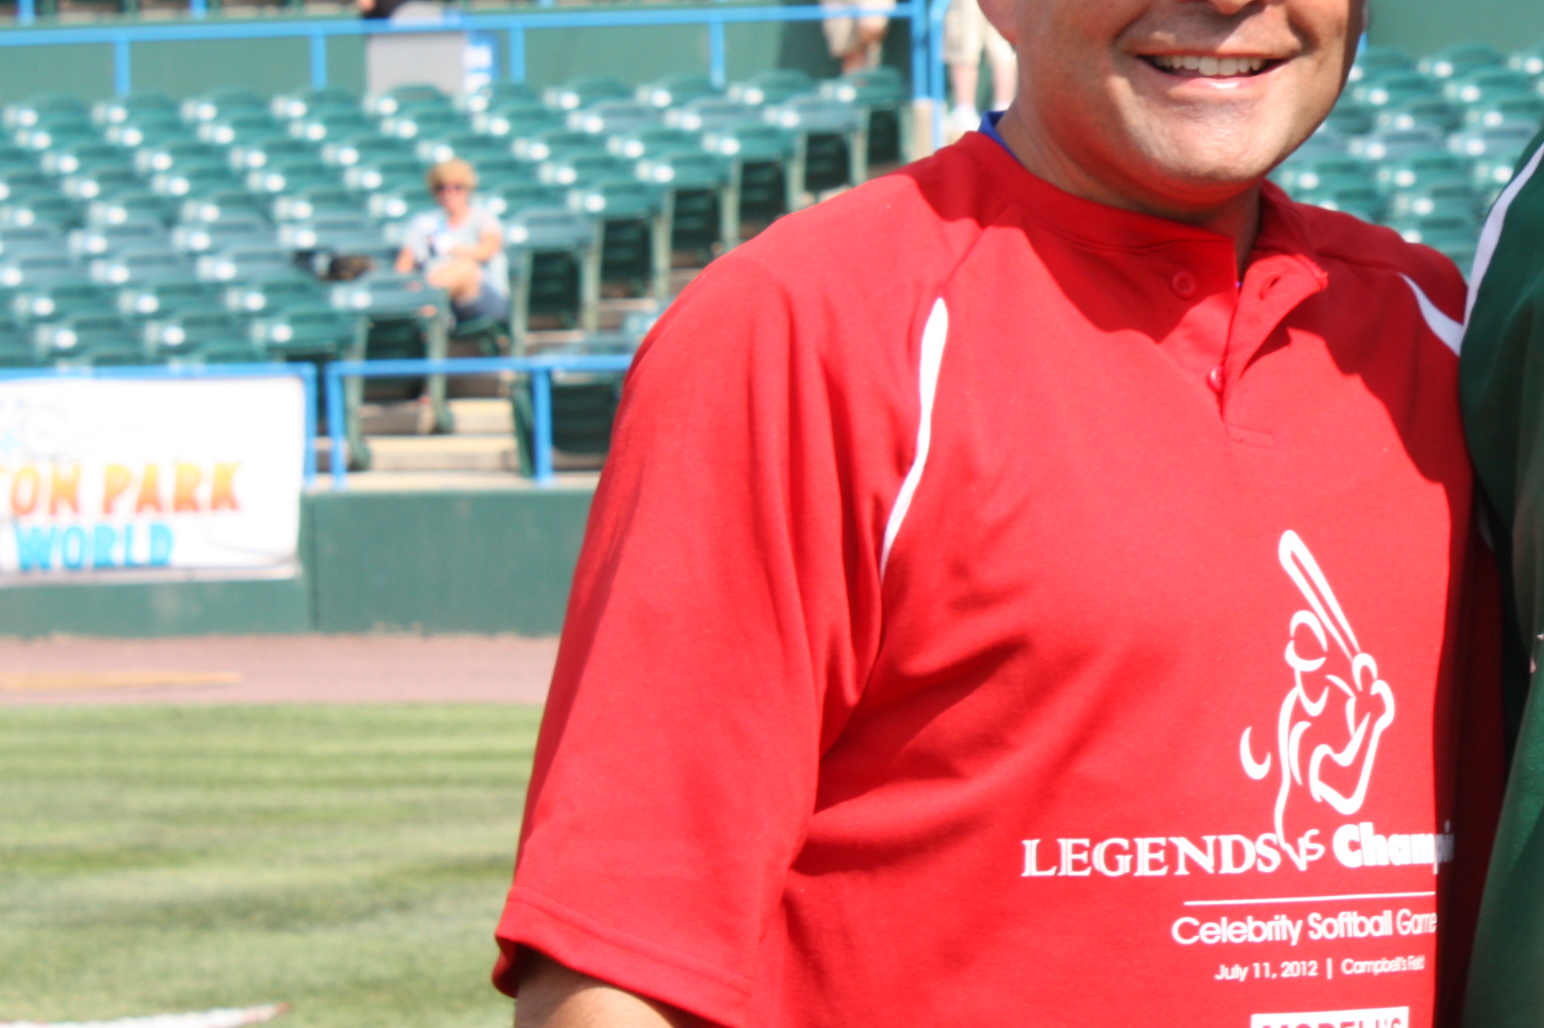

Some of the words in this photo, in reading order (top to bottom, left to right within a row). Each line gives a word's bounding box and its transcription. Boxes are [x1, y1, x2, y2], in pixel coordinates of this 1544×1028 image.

[0, 461, 83, 517] ON
[102, 460, 243, 516] PARK
[14, 521, 175, 572] WORLD
[1020, 833, 1282, 878] LEGENDS
[1171, 915, 1303, 946] Celebrity
[1307, 910, 1393, 940] Softball
[1396, 908, 1438, 935] Game
[1214, 963, 1249, 982] July
[1280, 960, 1318, 978] 2012
